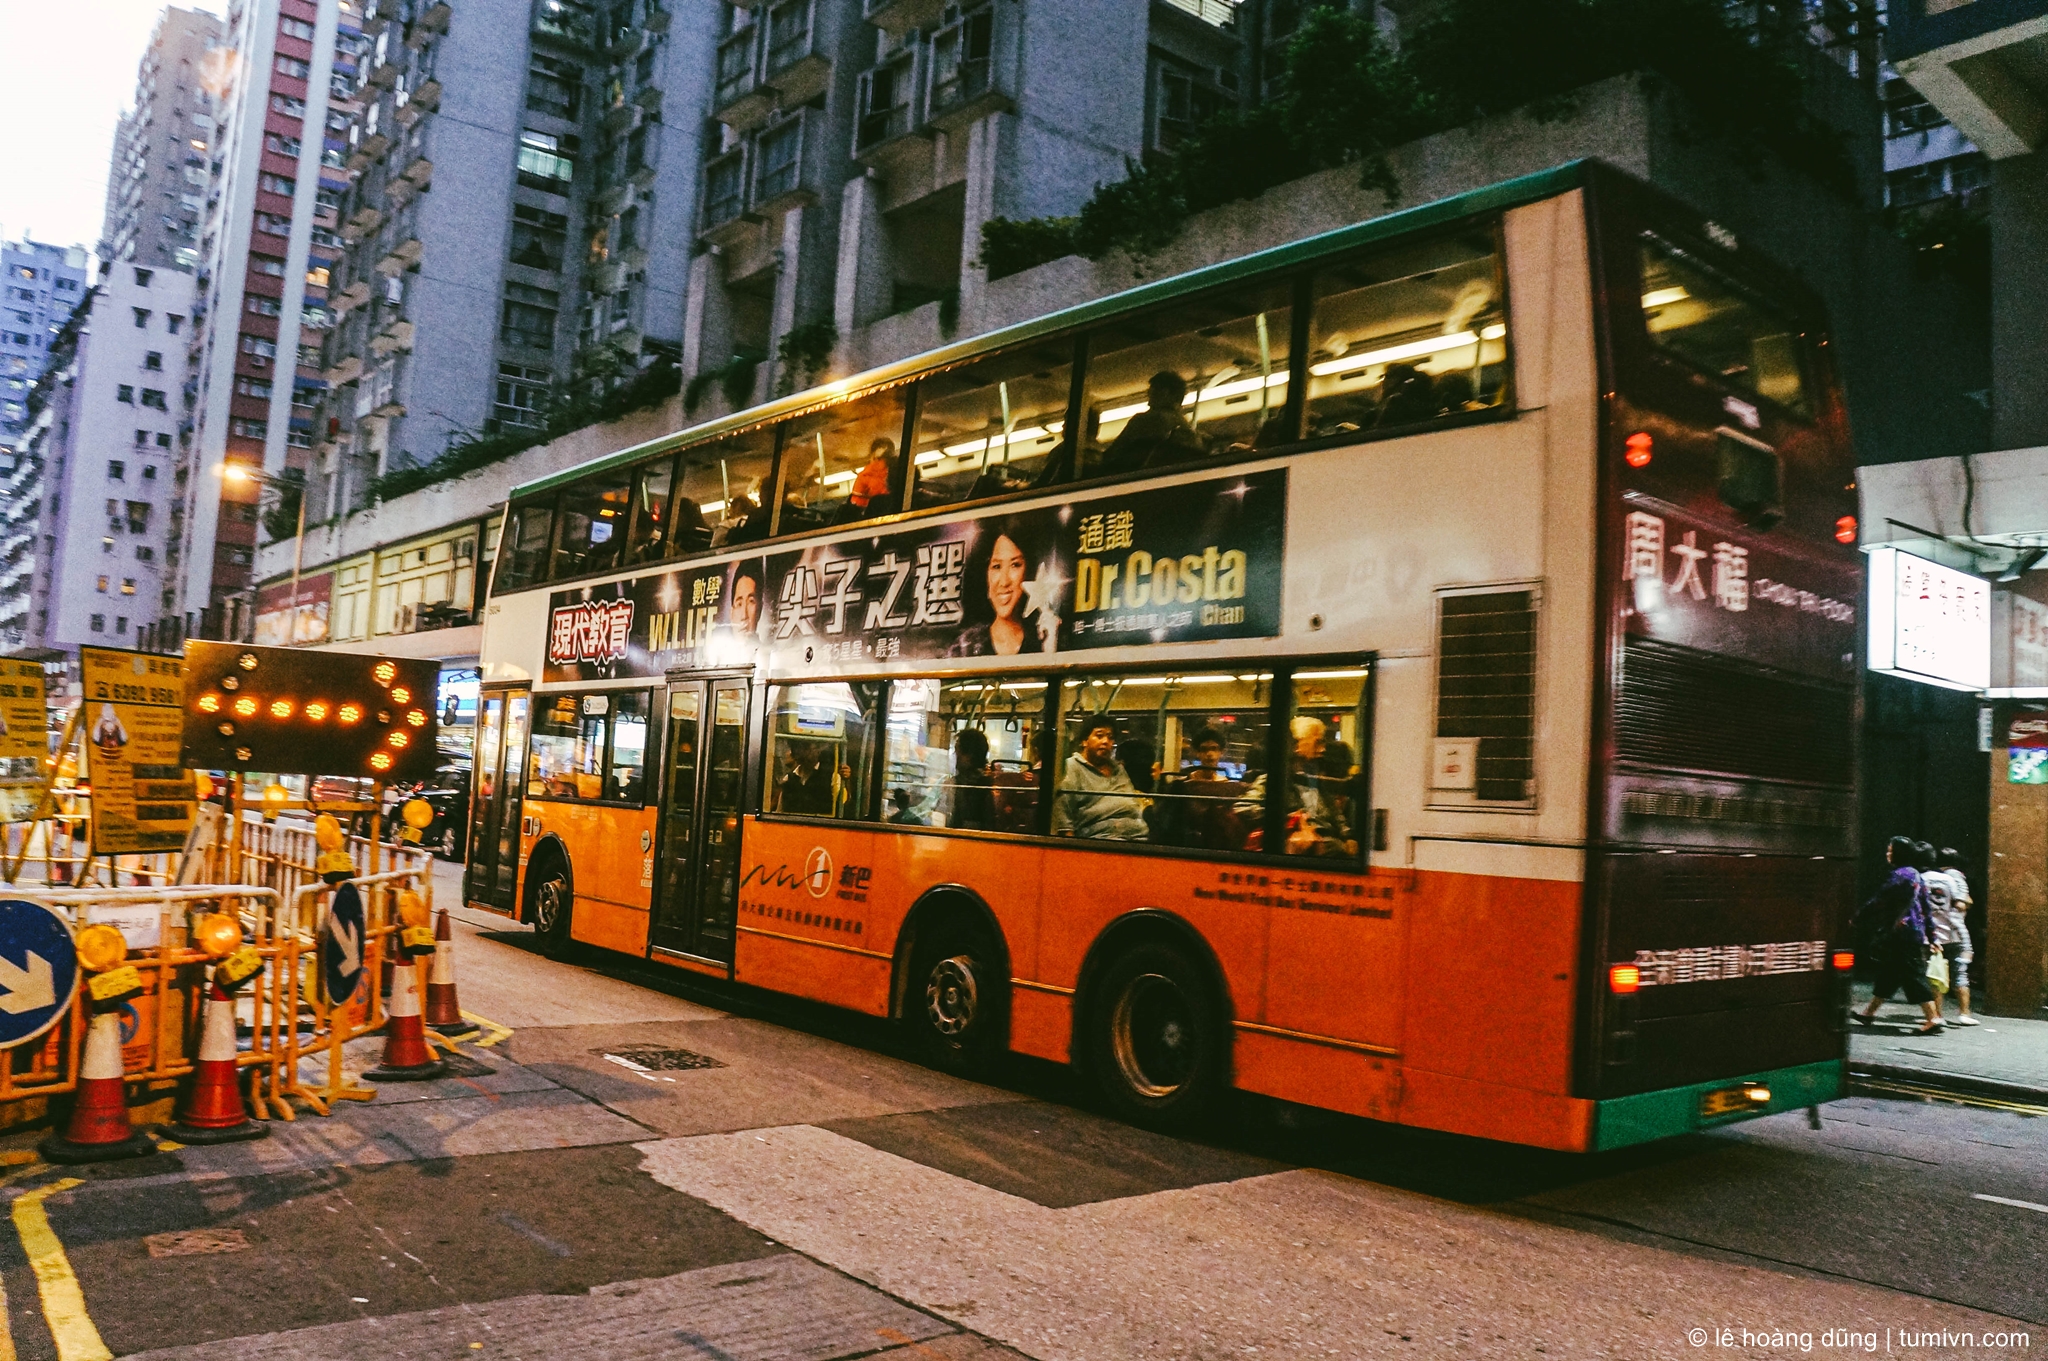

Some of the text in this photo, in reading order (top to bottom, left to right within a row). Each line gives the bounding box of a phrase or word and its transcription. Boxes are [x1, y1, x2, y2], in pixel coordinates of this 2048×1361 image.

[1077, 509, 1134, 554] 通識
[692, 575, 721, 606] 數學
[776, 541, 965, 639] 尖子之選
[551, 601, 633, 660] 現代教育
[839, 864, 871, 891] 新巴
